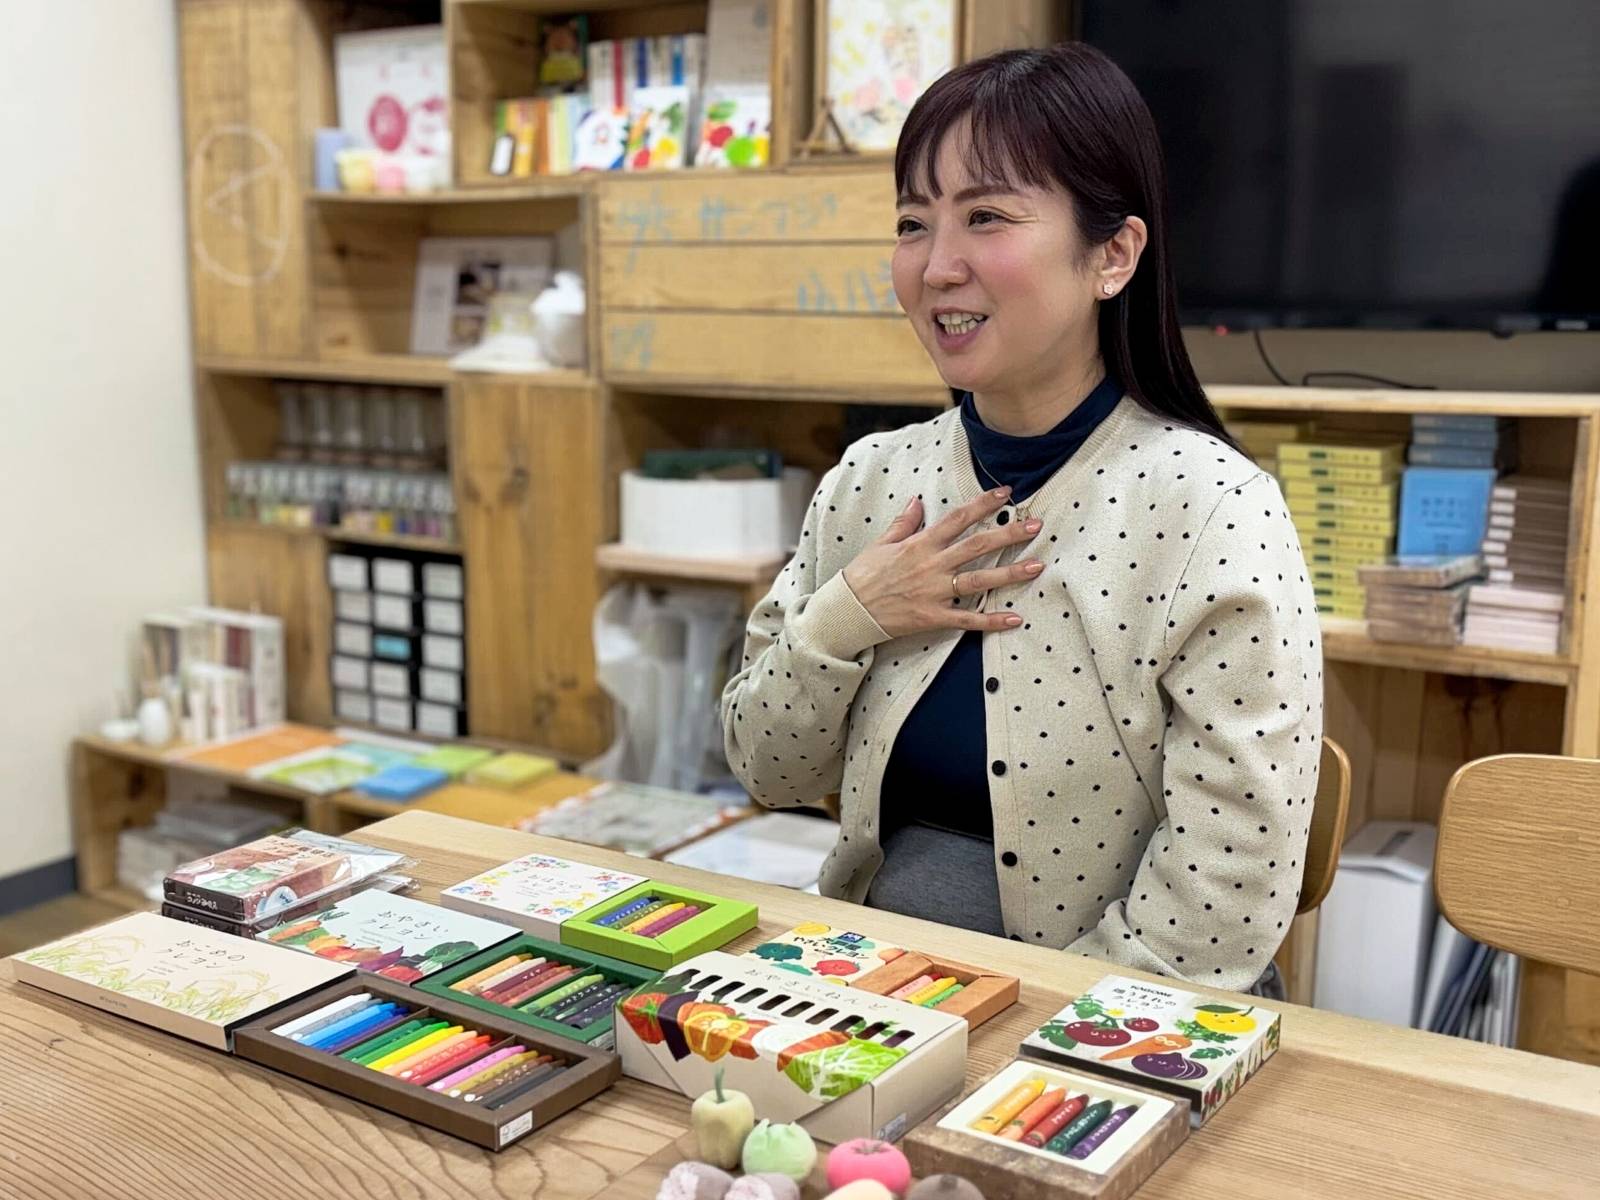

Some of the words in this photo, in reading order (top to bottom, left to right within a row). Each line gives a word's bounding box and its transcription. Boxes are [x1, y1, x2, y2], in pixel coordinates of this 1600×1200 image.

[378, 910, 449, 933] おやさい
[176, 939, 245, 961] おこめの
[793, 936, 870, 960] やさいクレヨン
